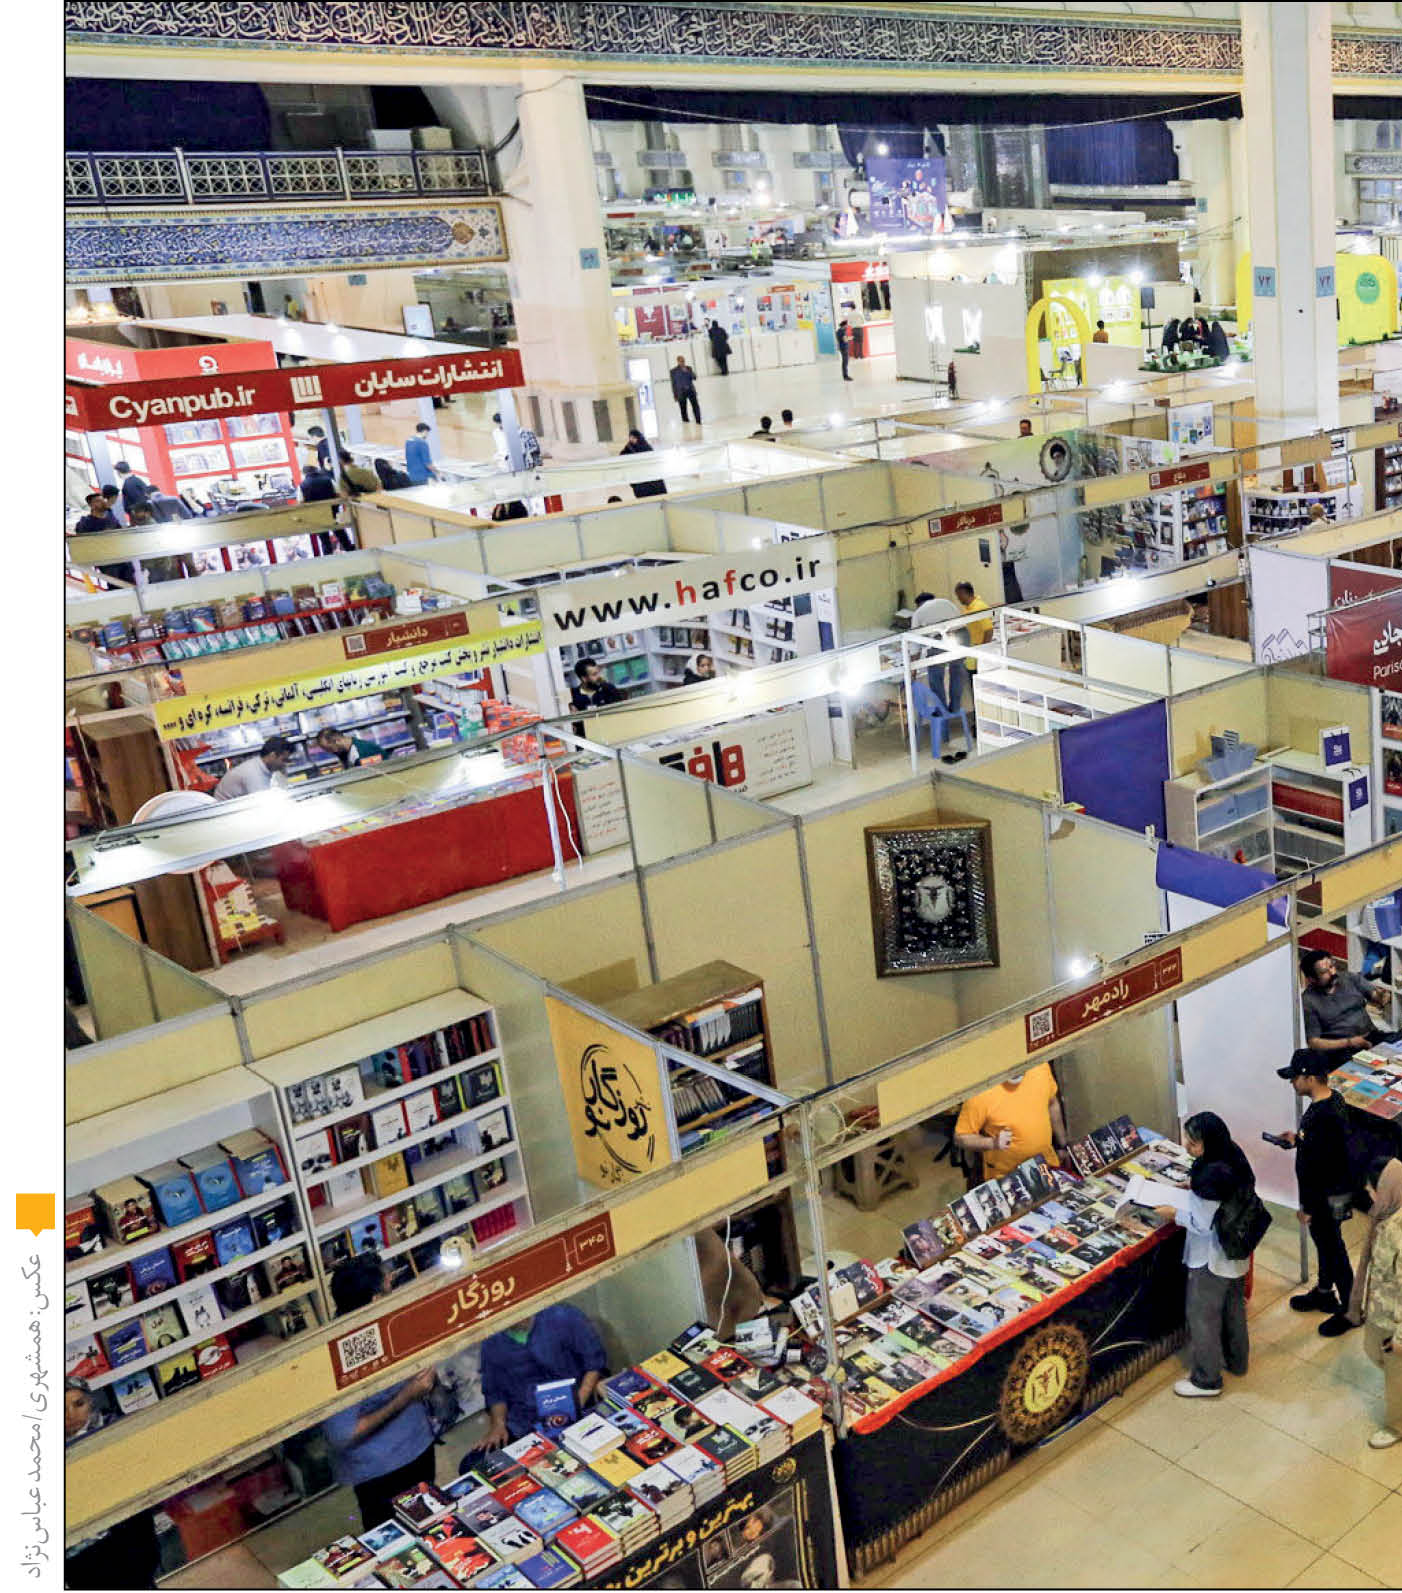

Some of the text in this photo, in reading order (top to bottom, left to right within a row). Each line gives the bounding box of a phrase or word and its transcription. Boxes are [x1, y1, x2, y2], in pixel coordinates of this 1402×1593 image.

[354, 359, 504, 397] انتشارات سایان
[109, 385, 256, 423] Cyanpub.ir
[553, 556, 821, 631] www.hafco.ir
[386, 623, 429, 647] دانشیار
[1081, 977, 1130, 1018] رادمهر
[578, 1232, 606, 1252] ۳۴۵
[447, 1275, 516, 1324] روزگار
[625, 1491, 754, 1588] بهترین و برترین
